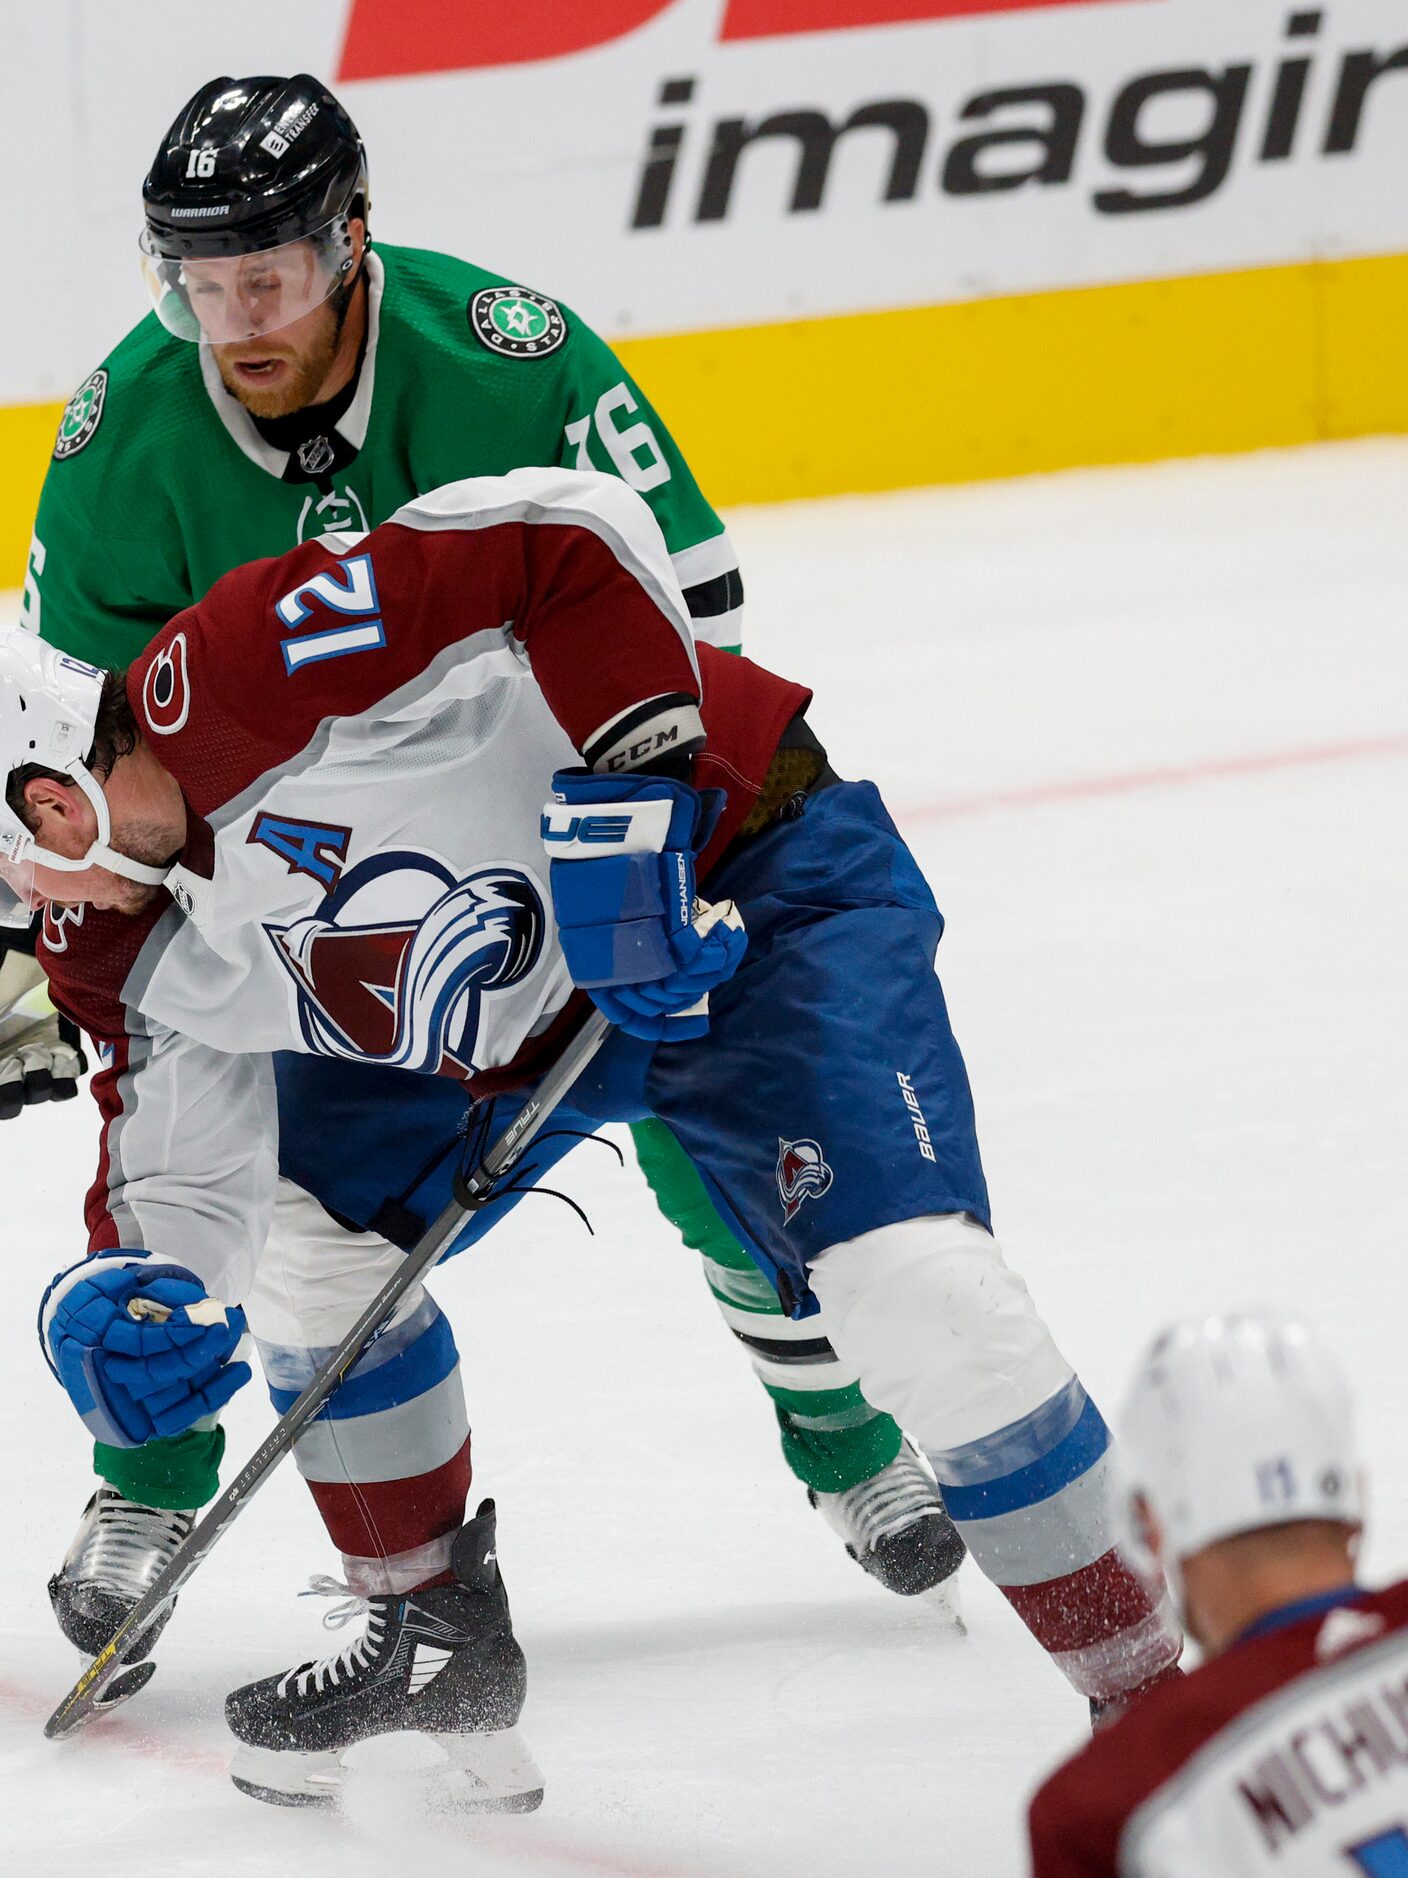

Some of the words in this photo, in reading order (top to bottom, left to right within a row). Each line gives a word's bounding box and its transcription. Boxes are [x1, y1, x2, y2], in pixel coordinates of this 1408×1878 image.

[284, 102, 320, 142] TRANSFER
[185, 149, 217, 178] 16
[170, 204, 230, 218] WARRIOR
[275, 553, 388, 677] 12
[606, 724, 678, 774] CCM
[245, 809, 353, 897] A
[675, 852, 688, 927] JOHANSEN
[504, 1101, 540, 1146] TRUE
[896, 1071, 936, 1163] BAUER
[240, 1427, 287, 1488] CATALYST
